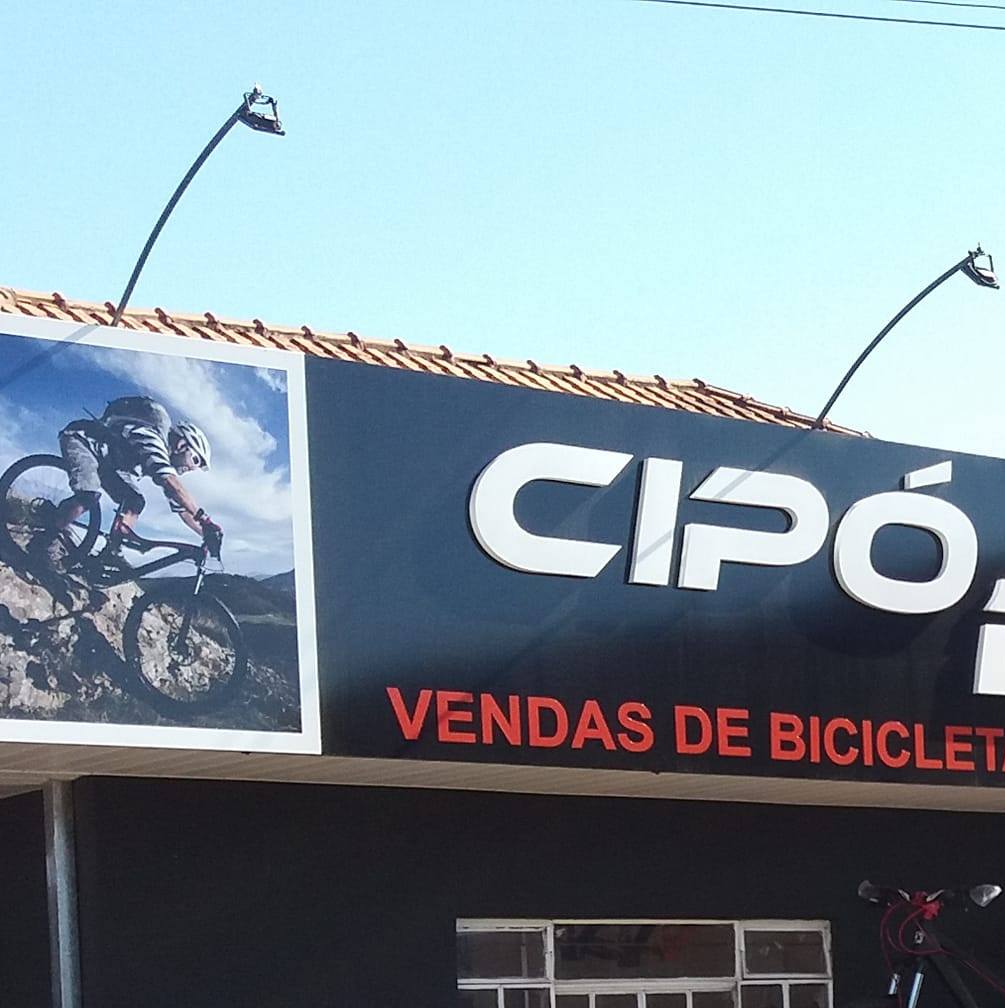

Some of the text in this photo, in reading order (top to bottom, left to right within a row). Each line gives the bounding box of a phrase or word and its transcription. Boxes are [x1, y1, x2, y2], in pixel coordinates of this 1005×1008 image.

[469, 442, 978, 614] CIPÓ
[386, 686, 655, 754] VENDAS
[674, 705, 752, 757] DE
